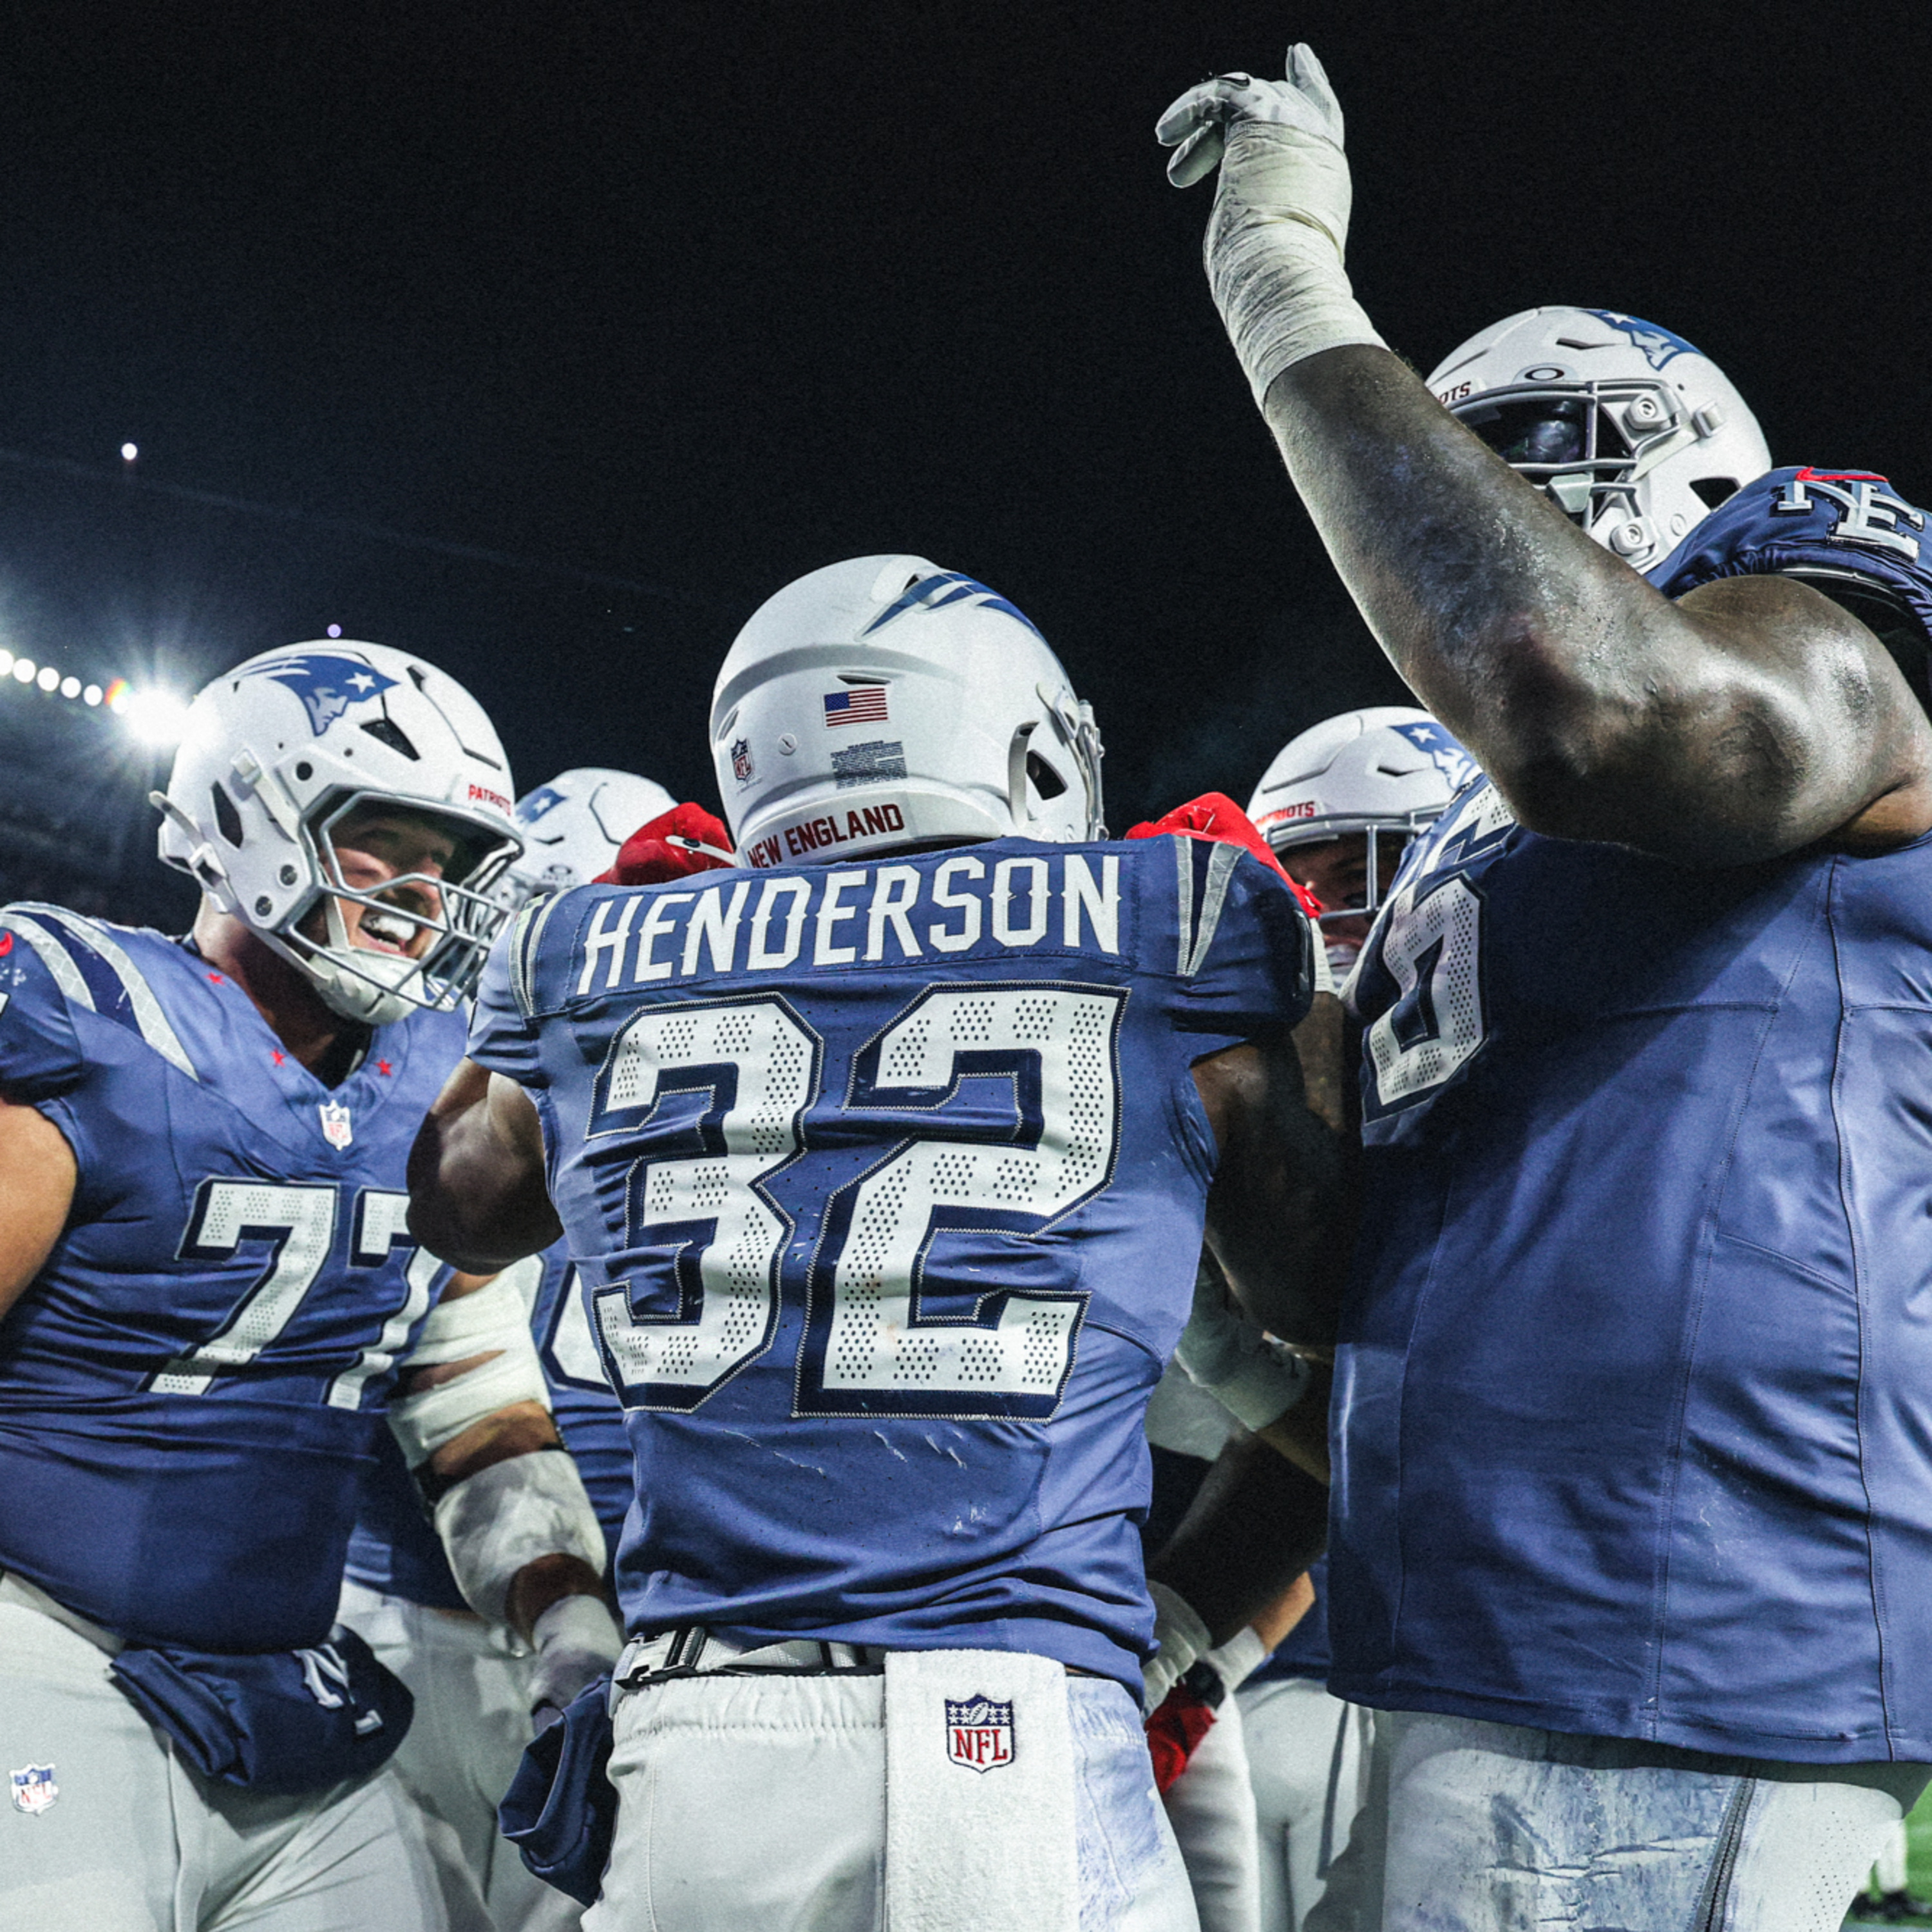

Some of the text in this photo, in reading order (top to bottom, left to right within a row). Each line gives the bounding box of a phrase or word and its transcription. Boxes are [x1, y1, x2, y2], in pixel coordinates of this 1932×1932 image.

[1776, 480, 1924, 563] NE
[748, 804, 905, 869] NEW ENGLAND
[576, 855, 1122, 995] HENDERSON
[589, 983, 1128, 1419] 32
[137, 1178, 450, 1412] 77
[953, 1728, 1008, 1765] NFL
